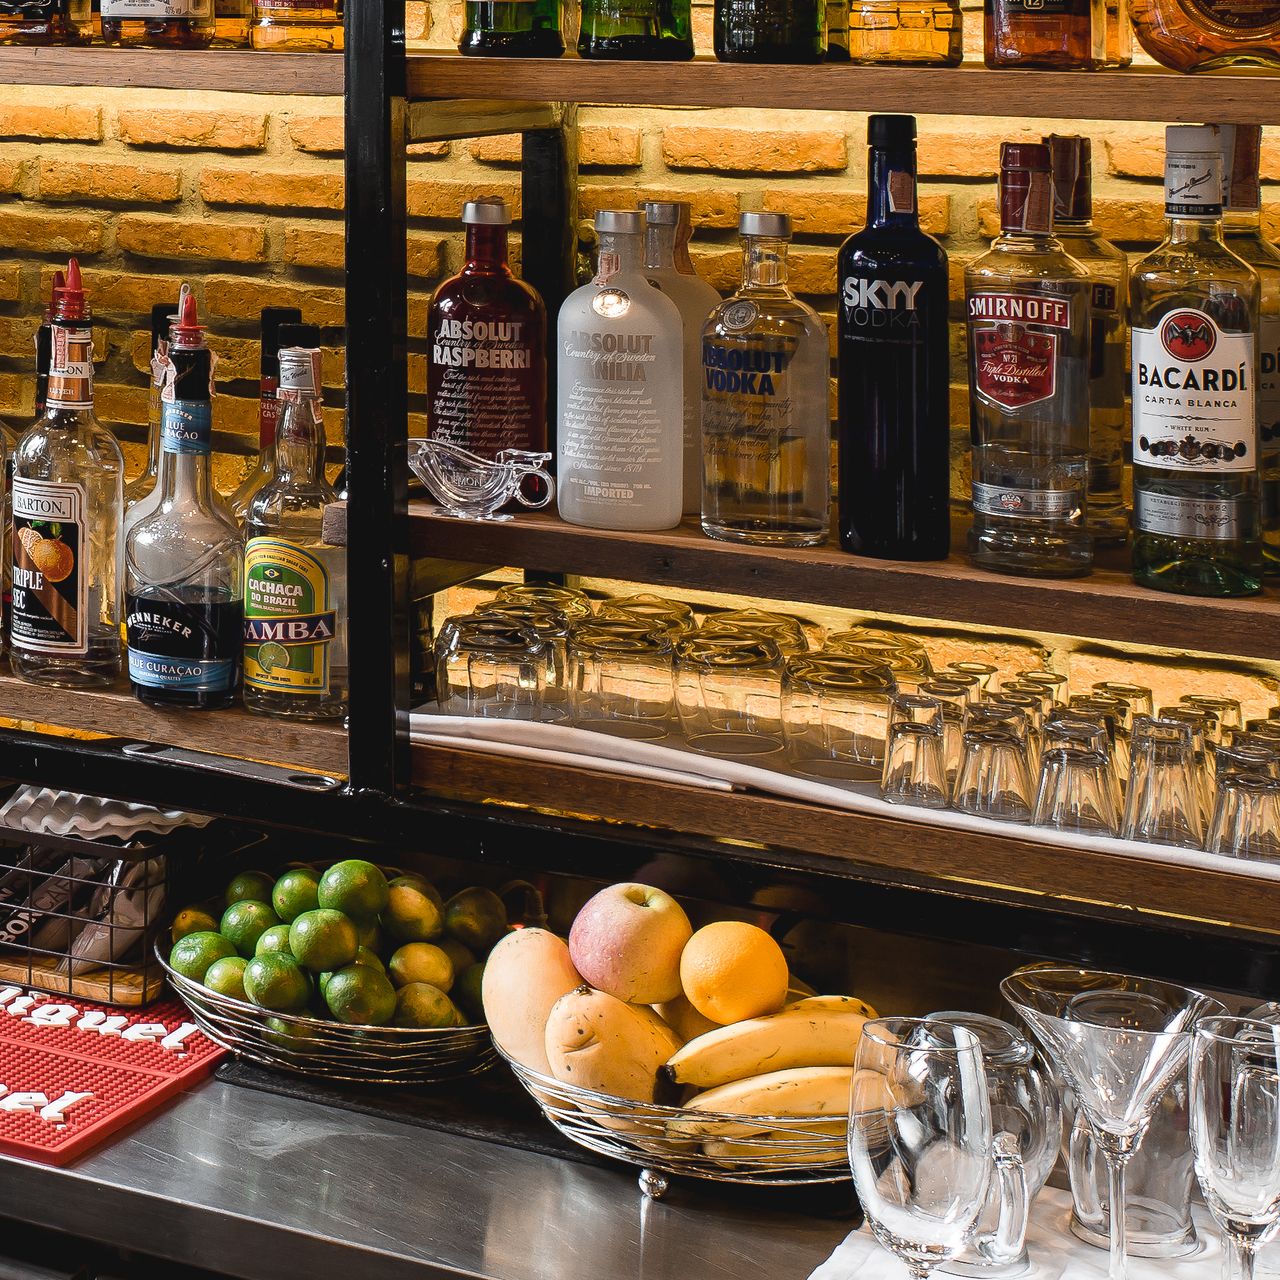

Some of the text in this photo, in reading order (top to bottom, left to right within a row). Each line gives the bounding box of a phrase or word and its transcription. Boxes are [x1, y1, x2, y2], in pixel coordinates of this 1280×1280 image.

[844, 276, 924, 310] SKYY
[845, 307, 921, 328] VODKA
[969, 296, 1064, 322] SMIRNOFF
[440, 319, 523, 341] ABSOLUT
[433, 344, 531, 369] RASPBERRI
[563, 340, 602, 365] Country
[617, 350, 657, 363] Sweden
[703, 343, 786, 374] ABSOLUT
[993, 373, 1030, 385] VODKA
[1002, 362, 1048, 377] Distilled
[1138, 361, 1248, 392] BACARDÍ
[705, 367, 776, 396] VODKA
[1144, 394, 1238, 408] CARTA BLANCA
[583, 485, 634, 499] IMPORTED
[17, 495, 64, 514] BARTON
[248, 578, 304, 597] CACHAÇA
[251, 591, 298, 607] DO BRAZIL
[127, 611, 193, 639] WENNEKER
[244, 619, 332, 641] AMBA
[146, 661, 202, 677] CURAÇAO
